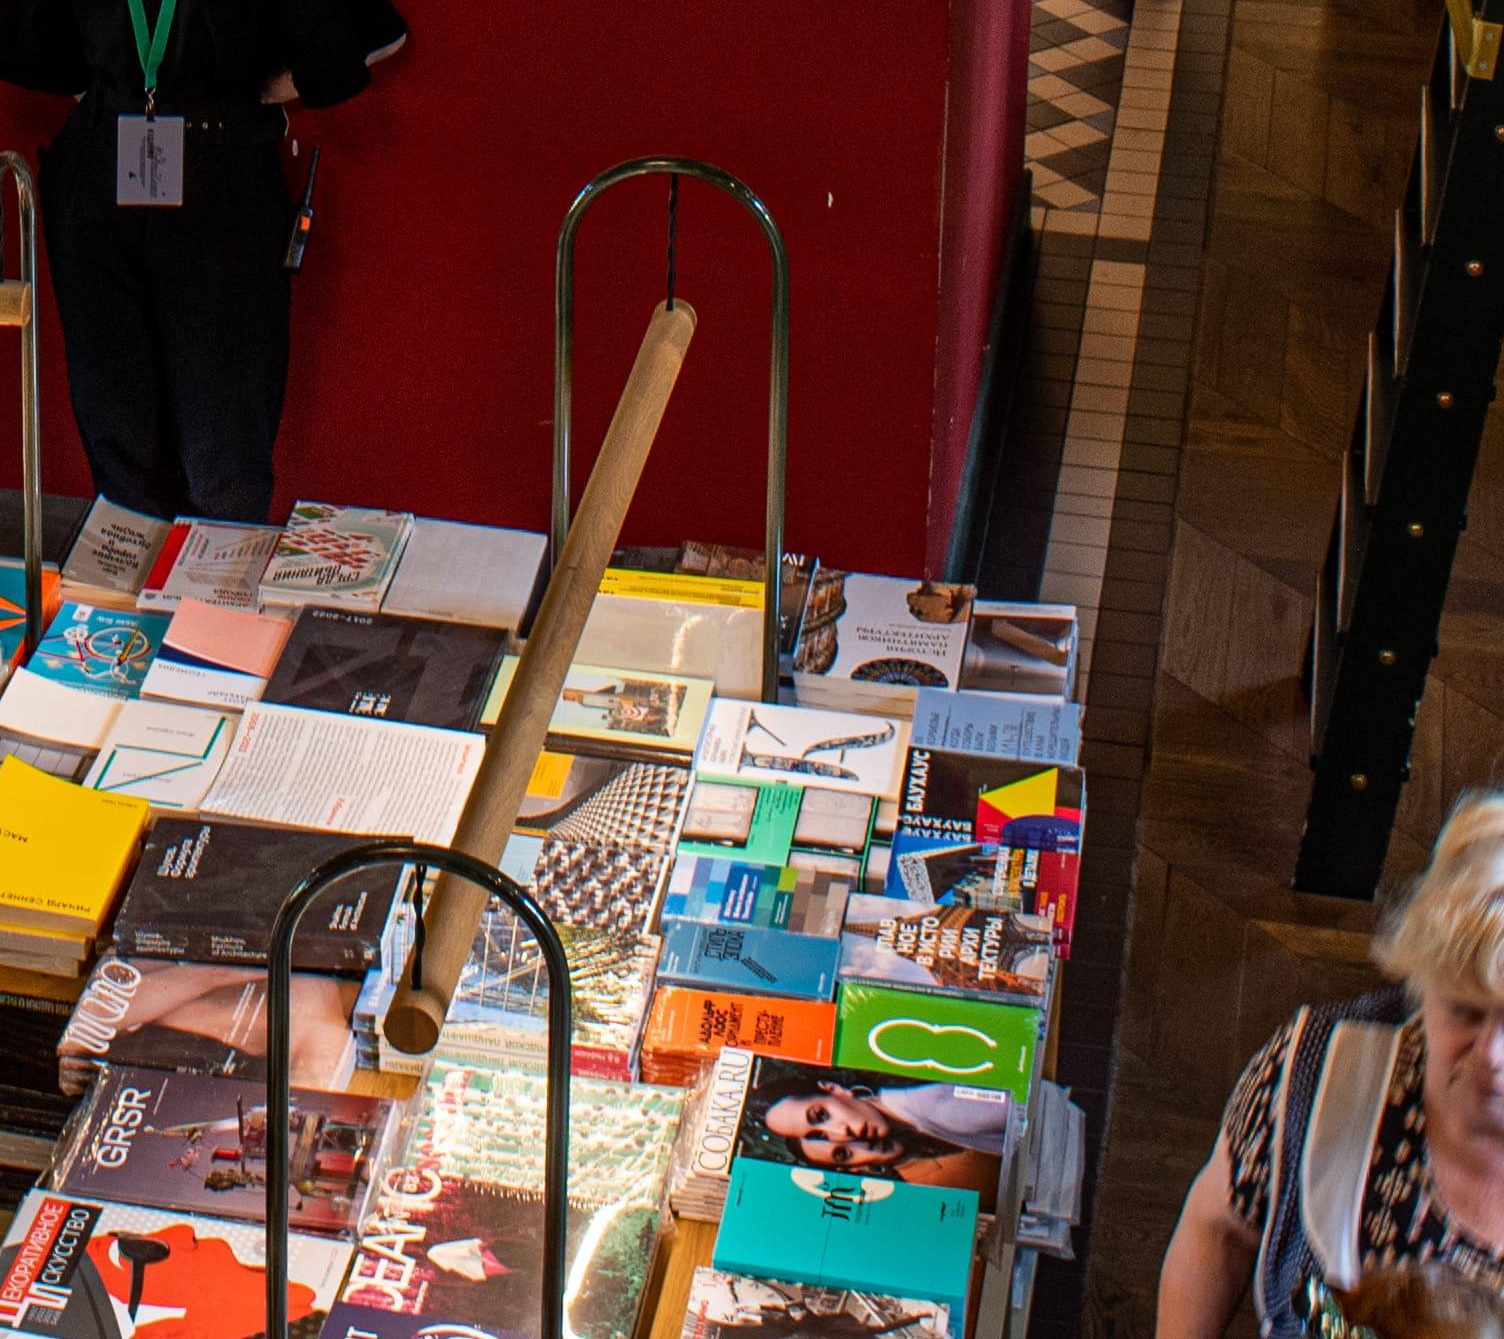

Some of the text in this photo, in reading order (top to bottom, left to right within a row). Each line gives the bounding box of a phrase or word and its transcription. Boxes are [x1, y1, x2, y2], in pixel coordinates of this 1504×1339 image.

[905, 750, 931, 812] БАУХАУС
[44, 895, 92, 915] РИЧАРД
[896, 921, 919, 955] НОЕ
[918, 916, 940, 968] В ИСТО
[938, 928, 957, 959] РИИ
[958, 927, 981, 966] АРХИ
[977, 917, 1003, 981] ТЕКТУРЫ
[96, 1086, 152, 1170] GRSR
